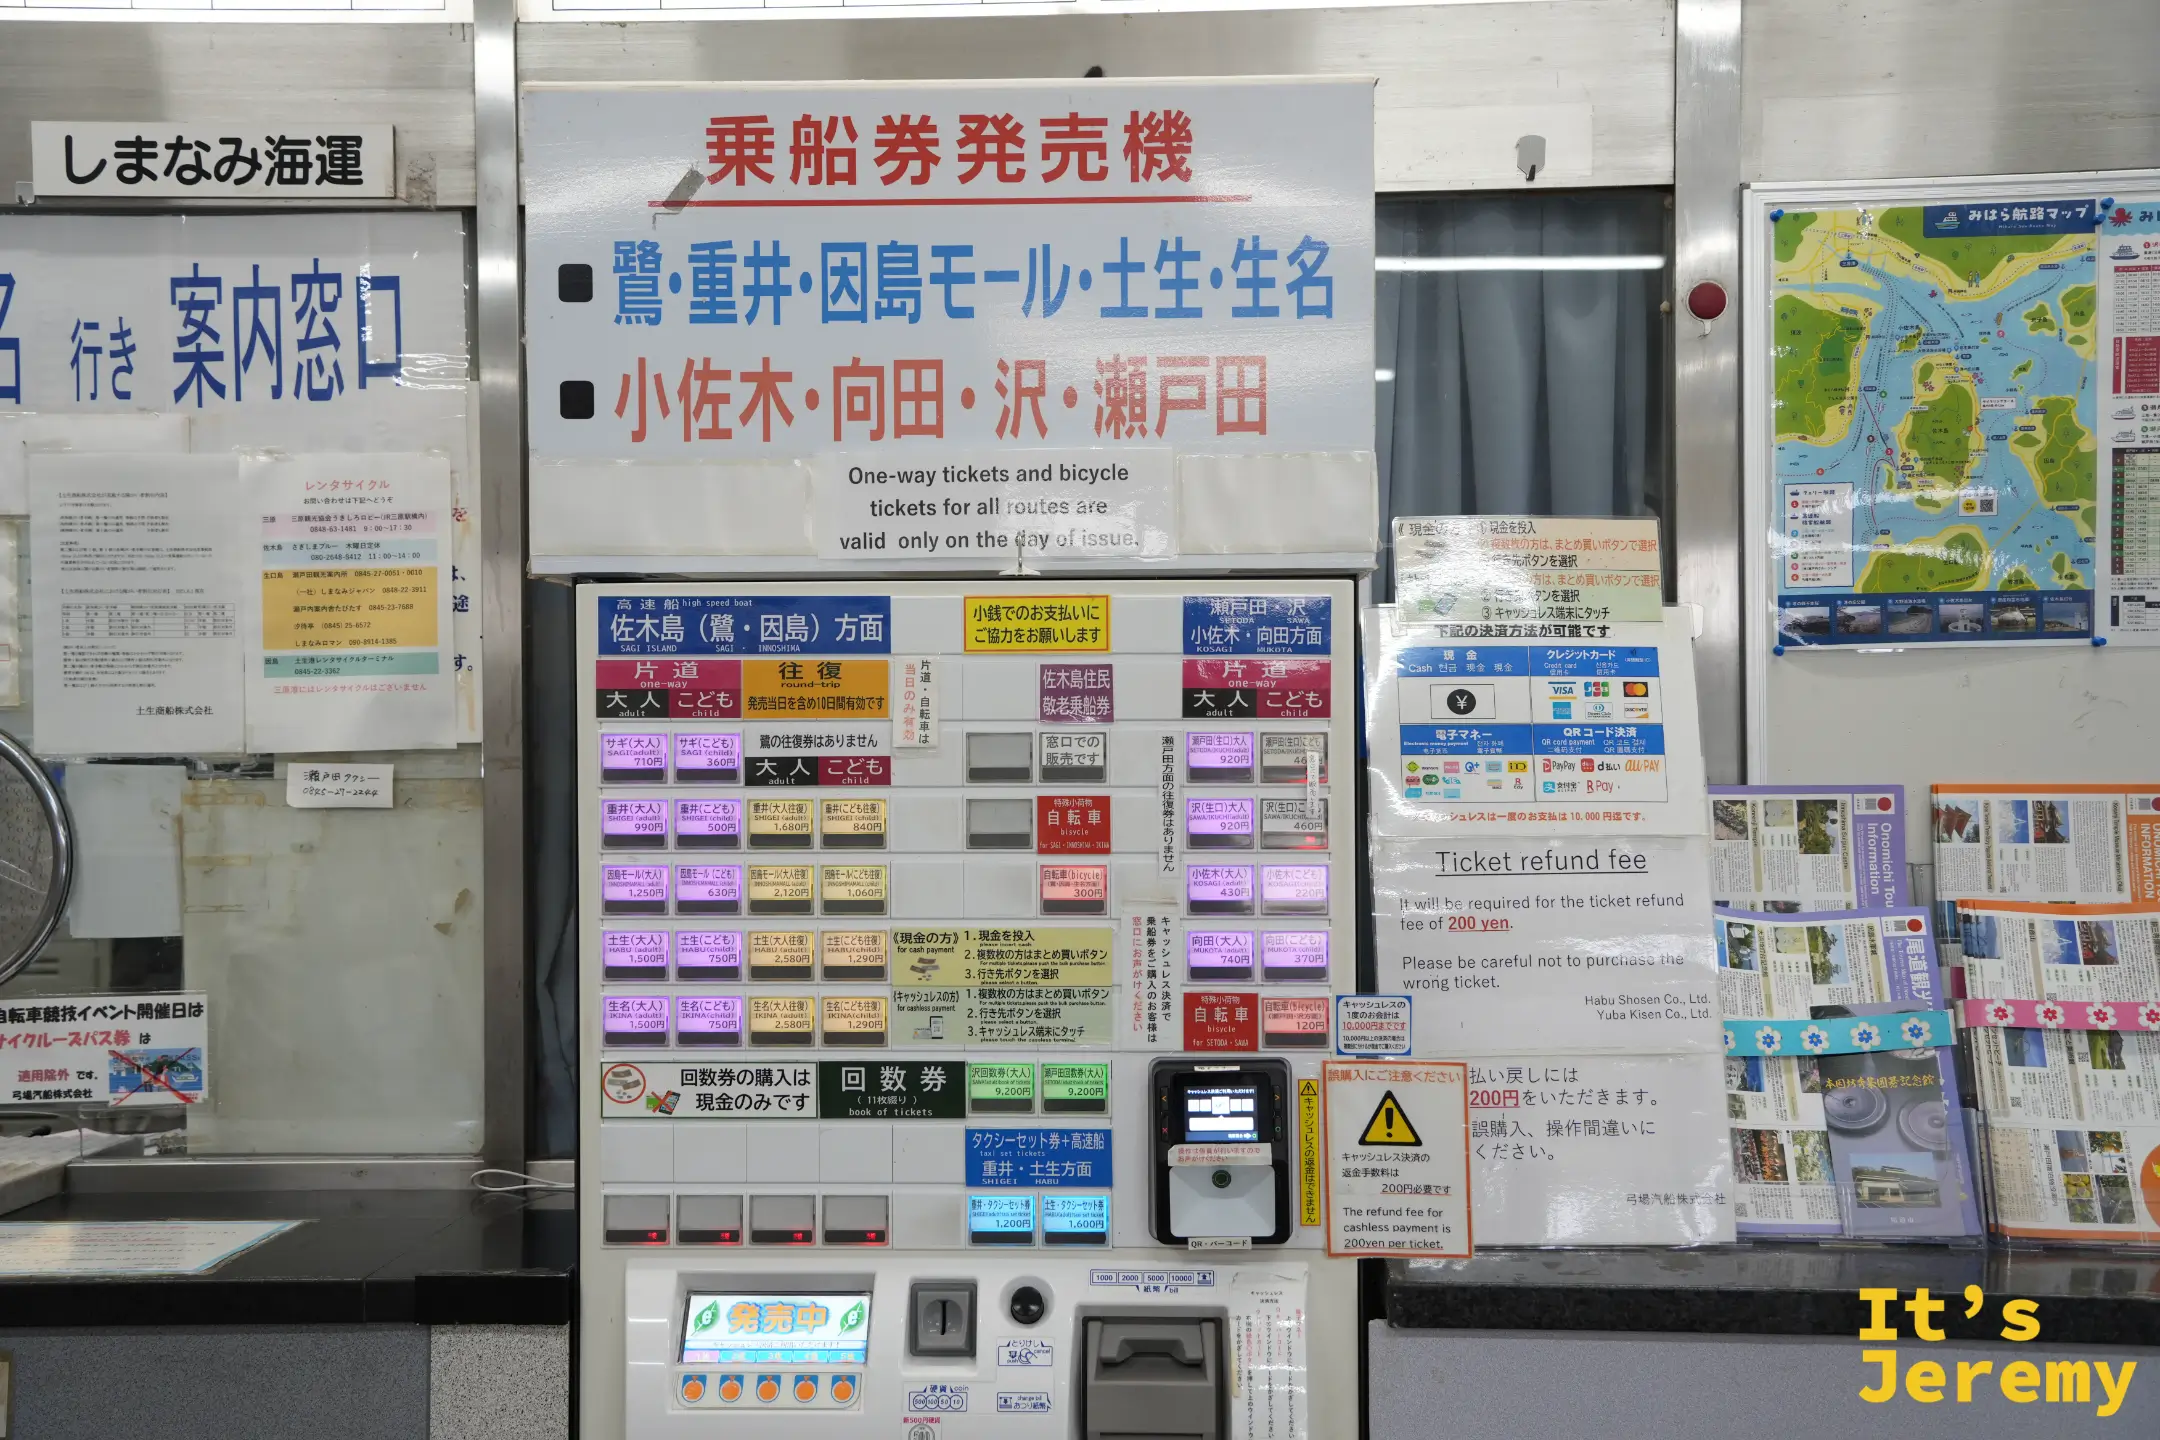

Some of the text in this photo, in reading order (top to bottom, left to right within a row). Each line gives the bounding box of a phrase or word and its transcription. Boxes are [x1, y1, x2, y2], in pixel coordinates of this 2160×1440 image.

[704, 109, 1195, 188] 乗船券発売機
[64, 134, 364, 186] しまなみ海運
[1968, 206, 2089, 222] みはら航路マップ
[613, 234, 1335, 327] 鷺・重井・因島モール・土生・生名
[70, 316, 136, 402] 行き
[169, 257, 402, 408] 案内窓口
[614, 353, 1269, 444] 小佐木・向田・沢・瀬戸田
[849, 463, 1129, 487] One-way tickets and bicycle
[305, 480, 390, 491] レンタサイクル
[303, 496, 393, 505] お問い合わせは下記へどうぞ
[870, 498, 1107, 517] tickets for all routes are
[838, 528, 1139, 552] valid only on the day of issue.
[616, 598, 680, 611] 高速船
[682, 599, 702, 607] high
[706, 600, 730, 608] speed
[973, 604, 1100, 622] 小銭でのお支払いに
[974, 627, 1101, 644] ご協力をお願いします
[1191, 626, 1322, 645] 小佐木・向田方面
[620, 644, 677, 652] SAGI ISLAND
[1546, 649, 1616, 660] クレジットカード
[634, 662, 700, 680] 片道
[778, 662, 842, 680] 往復
[1223, 661, 1288, 678] 片道
[1409, 663, 1433, 673] Cash
[640, 679, 688, 689] one-way
[780, 680, 840, 689] round-trip
[1043, 669, 1111, 689] 佐木島住民
[1228, 679, 1277, 688] one-way
[1553, 686, 1574, 695] VISA
[606, 690, 734, 708] 大人 こども
[748, 696, 884, 710] 発売当日を含め10日間有効です
[903, 664, 916, 741] 当日のみ有効
[919, 660, 931, 744] 片道・自転車は
[1043, 695, 1111, 716] 敬老乗船券
[136, 705, 214, 716] 土生商船株式会社
[692, 709, 720, 717] child
[1436, 729, 1492, 740] 電子マネー
[1564, 727, 1637, 737] QR コード決済
[760, 734, 878, 749] 鷺の往復券はありません
[1046, 736, 1100, 748] 窓口での
[635, 758, 663, 767] 710円
[1046, 753, 1099, 766] 販売です
[1220, 755, 1249, 763] 920円
[1552, 761, 1576, 772] PayPay
[1162, 736, 1174, 872] 瀬戸田方面の往復券はありません
[1048, 810, 1101, 826] 自転車
[635, 823, 809, 832] 990円 1,680円
[1867, 823, 1879, 895] Information
[1881, 823, 1893, 882] Onomichi
[1435, 849, 1647, 873] Ticket refund fee
[629, 888, 664, 897] 1,250円
[1074, 889, 1103, 898] 300円
[1400, 893, 1684, 913] It will be required for the ticket refund
[1400, 916, 1514, 931] fee of 200 yen.
[928, 946, 955, 955] payment
[629, 954, 665, 963] 1,500円
[1221, 954, 1324, 964] 740円 370円
[1132, 917, 1143, 1031] 窓口にお声がけください
[1161, 917, 1172, 1021] キャッシュレス決済で
[1147, 917, 1157, 1043] 乗船券をご購入のお客様は
[1343, 1001, 1406, 1009] キャッシュレスの
[1585, 994, 1711, 1006] Habu Shosen Co., Ltd.
[0, 1002, 204, 1024] 転車競技イベント開催日は
[709, 1020, 737, 1029] 750円
[140, 1032, 151, 1045] は
[18, 1068, 69, 1082] 適用除外
[681, 1068, 811, 1087] 回数券の購入は
[841, 1066, 947, 1092] 回数券
[1327, 1069, 1460, 1083] 誤購入にご注意ください
[1469, 1067, 1579, 1084] 払い戻しには
[696, 1093, 810, 1111] 現金のみです
[1470, 1089, 1657, 1107] 200円をいただきます。
[849, 1107, 933, 1117] book of tickets
[1304, 1098, 1316, 1223] キャッシュレスの返金はできません
[982, 1160, 1092, 1177] 重井・土生方面
[1341, 1168, 1399, 1178] 返金手数料は
[1382, 1184, 1451, 1194] 200円必要です
[1343, 1207, 1443, 1217] The refund fee for
[1343, 1222, 1451, 1235] cashless payment is
[1344, 1239, 1443, 1250] 200yen per ticket.
[1096, 1273, 1193, 1284] 1000 2000 5000 10000
[728, 1301, 829, 1334] 発売中
[1011, 1339, 1041, 1348] とりけし
